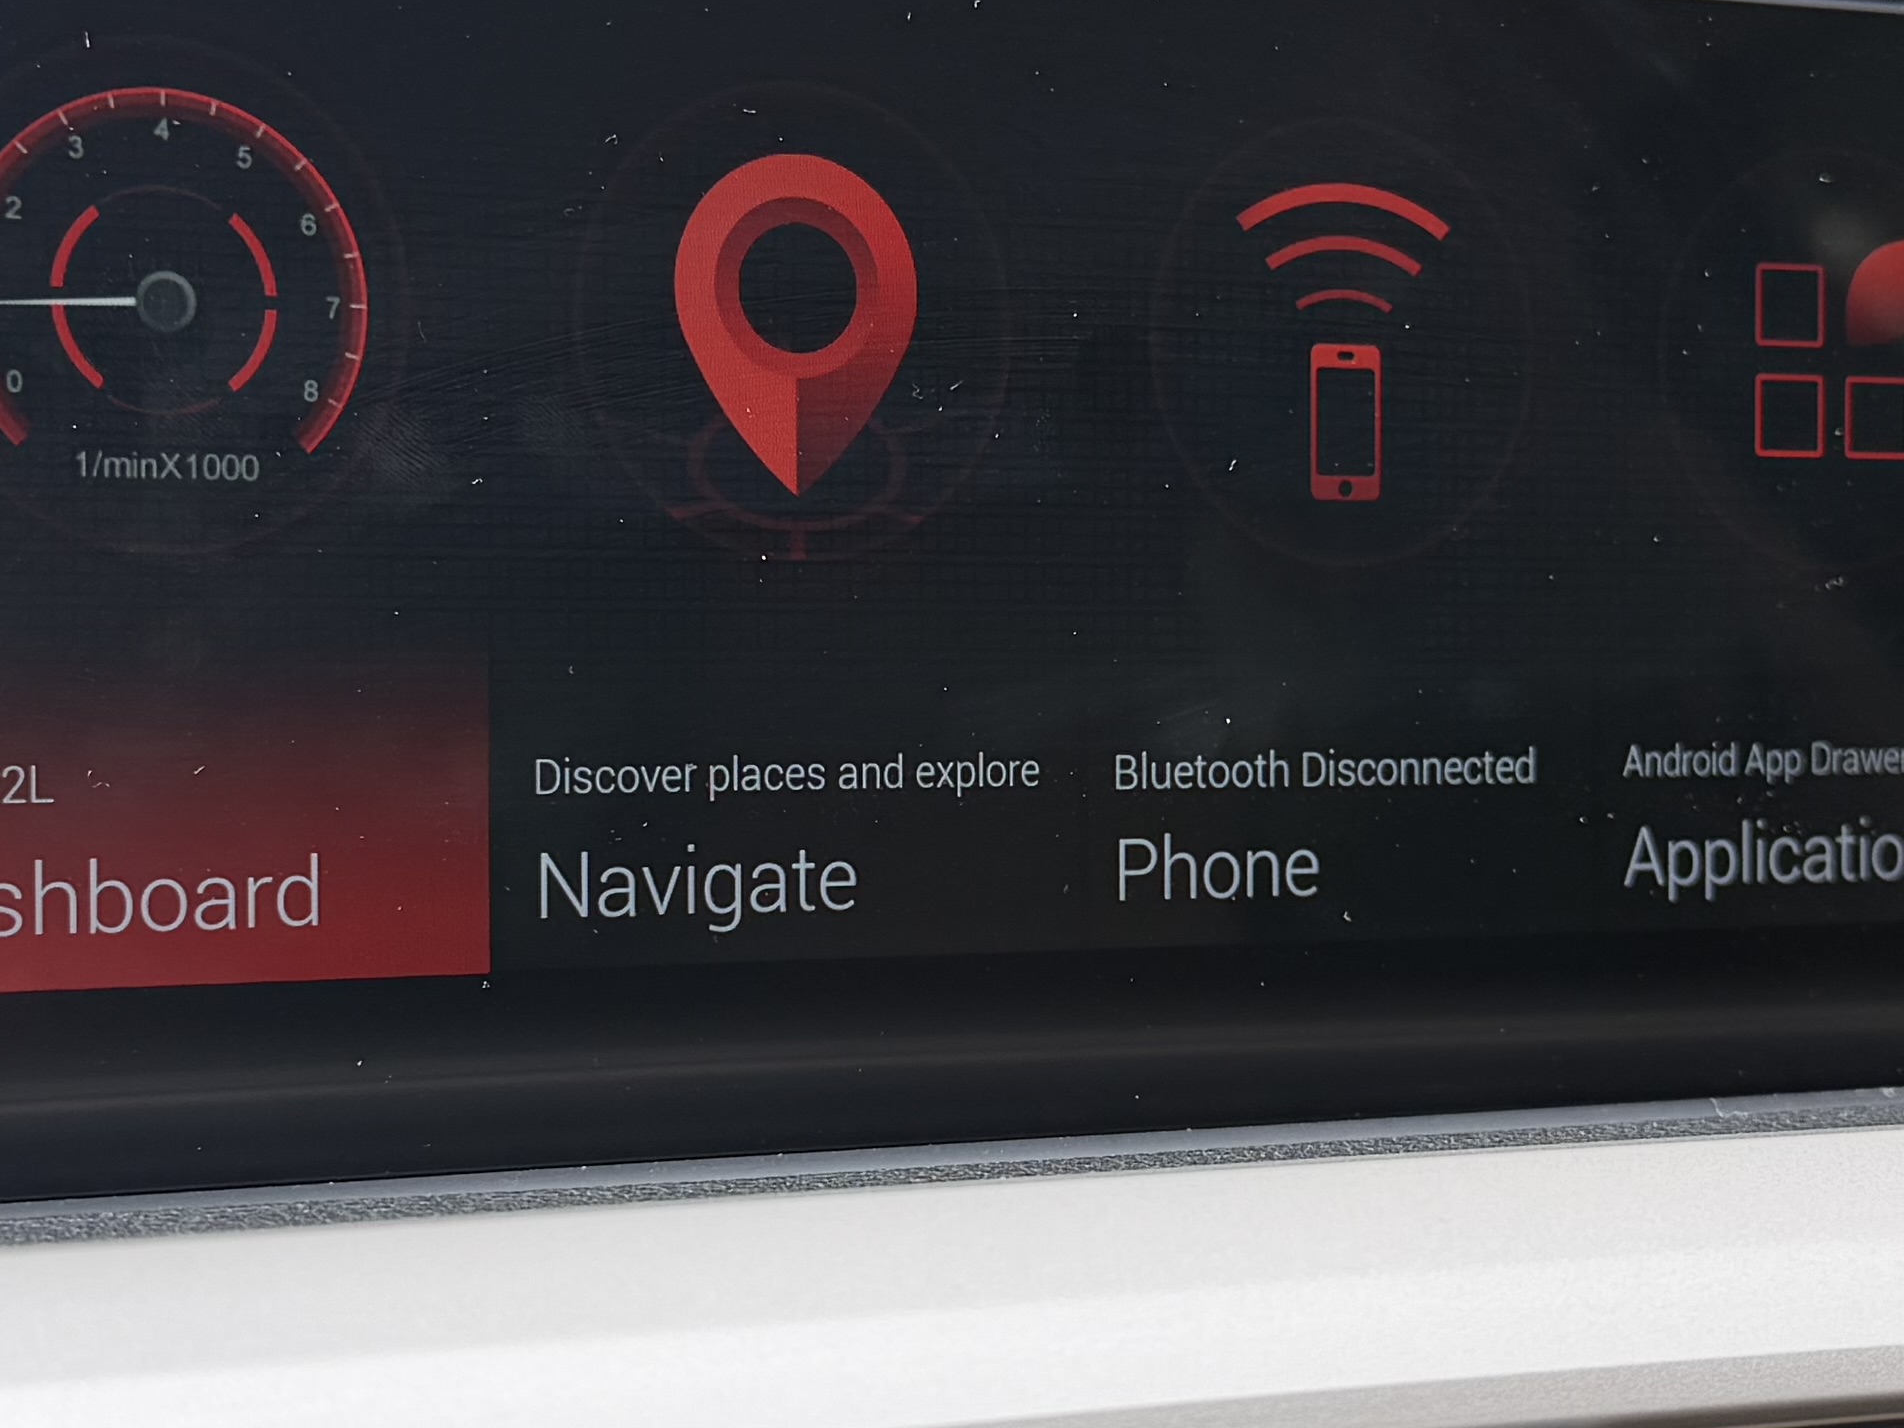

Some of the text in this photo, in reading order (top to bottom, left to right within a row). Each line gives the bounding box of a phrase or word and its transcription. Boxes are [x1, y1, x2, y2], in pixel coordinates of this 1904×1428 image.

[153, 117, 170, 141] 4
[67, 134, 85, 160] 3
[236, 145, 253, 170] 5
[4, 195, 23, 221] 2
[300, 213, 318, 237] 6
[325, 296, 342, 321] 7
[5, 369, 24, 394] 0
[303, 379, 320, 404] 8
[75, 449, 261, 483] 1/minX1000
[1114, 745, 1536, 792] Bluetooth Disconnected
[1622, 741, 1737, 778] Android
[1743, 743, 1803, 784] App
[534, 751, 1040, 802] Discover places and explore
[1117, 835, 1321, 903] Phone
[538, 843, 859, 934] Navigate
